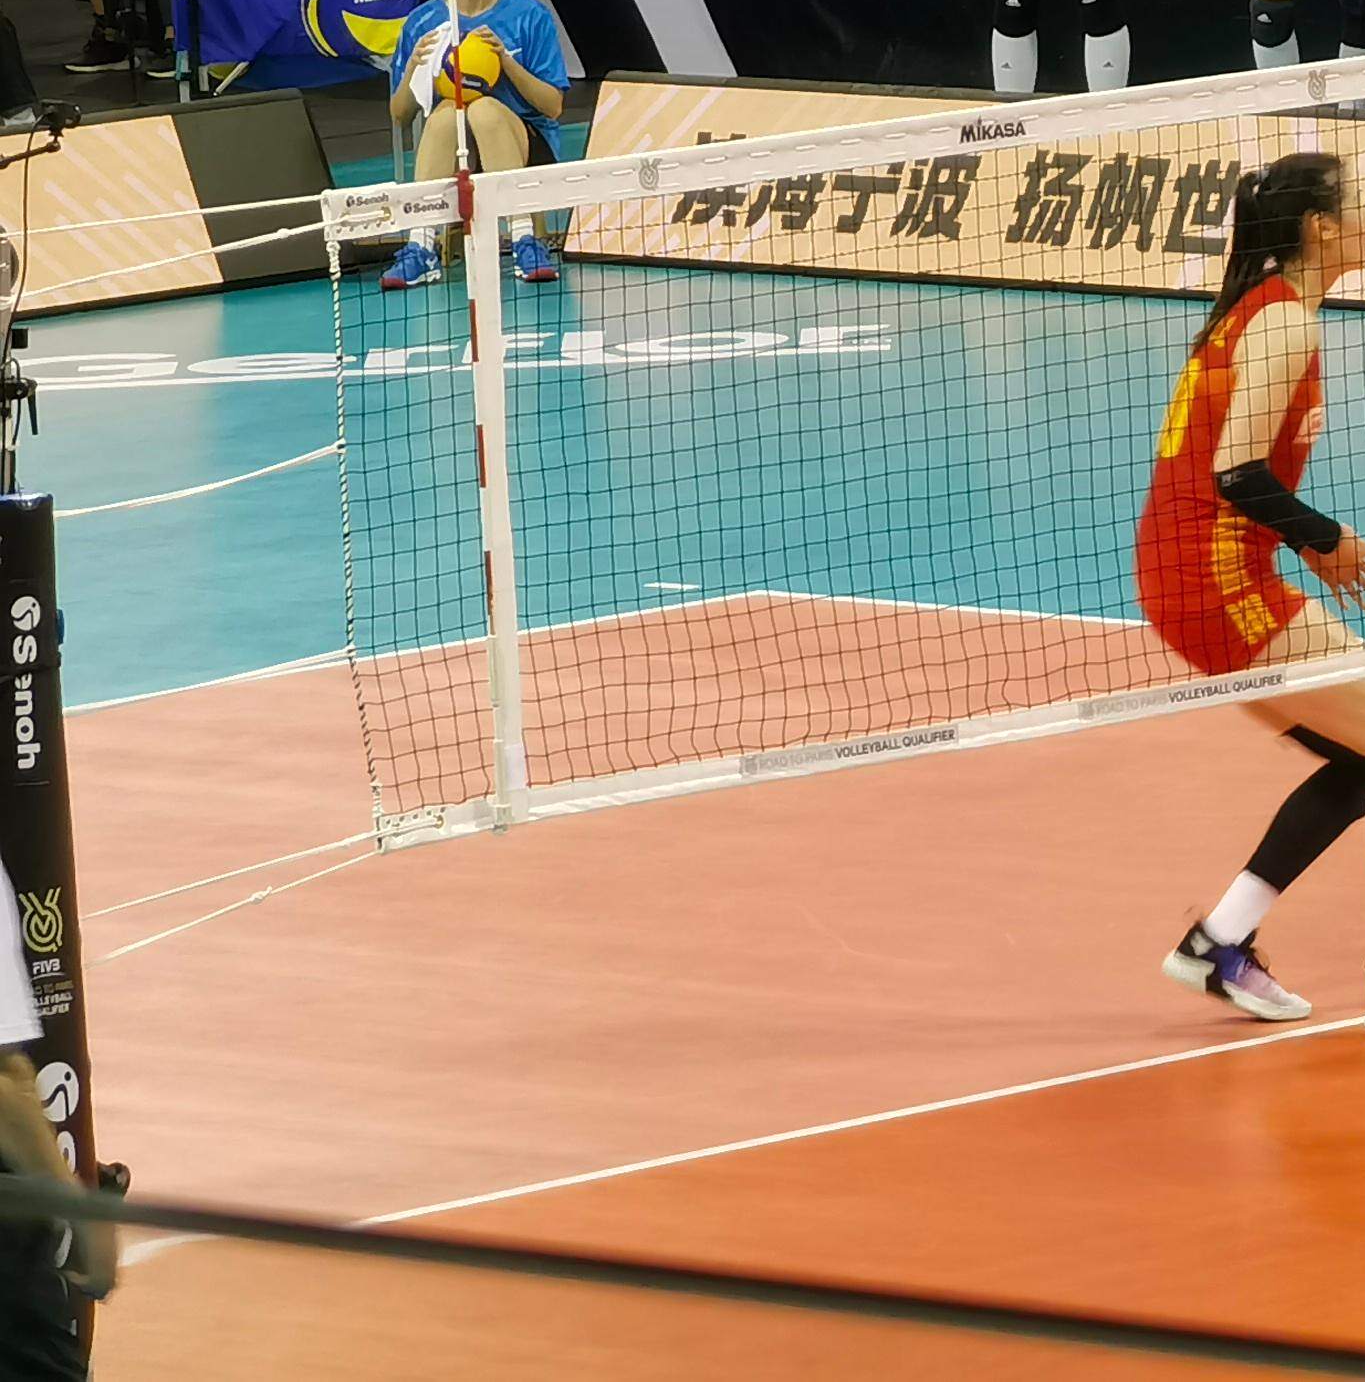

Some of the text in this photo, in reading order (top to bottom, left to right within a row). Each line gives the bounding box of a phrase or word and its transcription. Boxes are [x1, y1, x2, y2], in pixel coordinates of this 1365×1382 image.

[356, 193, 389, 208] Senoh
[413, 201, 450, 214] Senoh
[1005, 149, 1242, 256] 扬帆世
[13, 634, 41, 769] Senoh
[1169, 682, 1231, 704] VOLLEYBALL
[1233, 673, 1283, 693] QUALIFIER
[834, 738, 901, 759] VOLLEYBALL
[902, 729, 956, 748] QUALIFIER
[32, 958, 61, 975] FIVB
